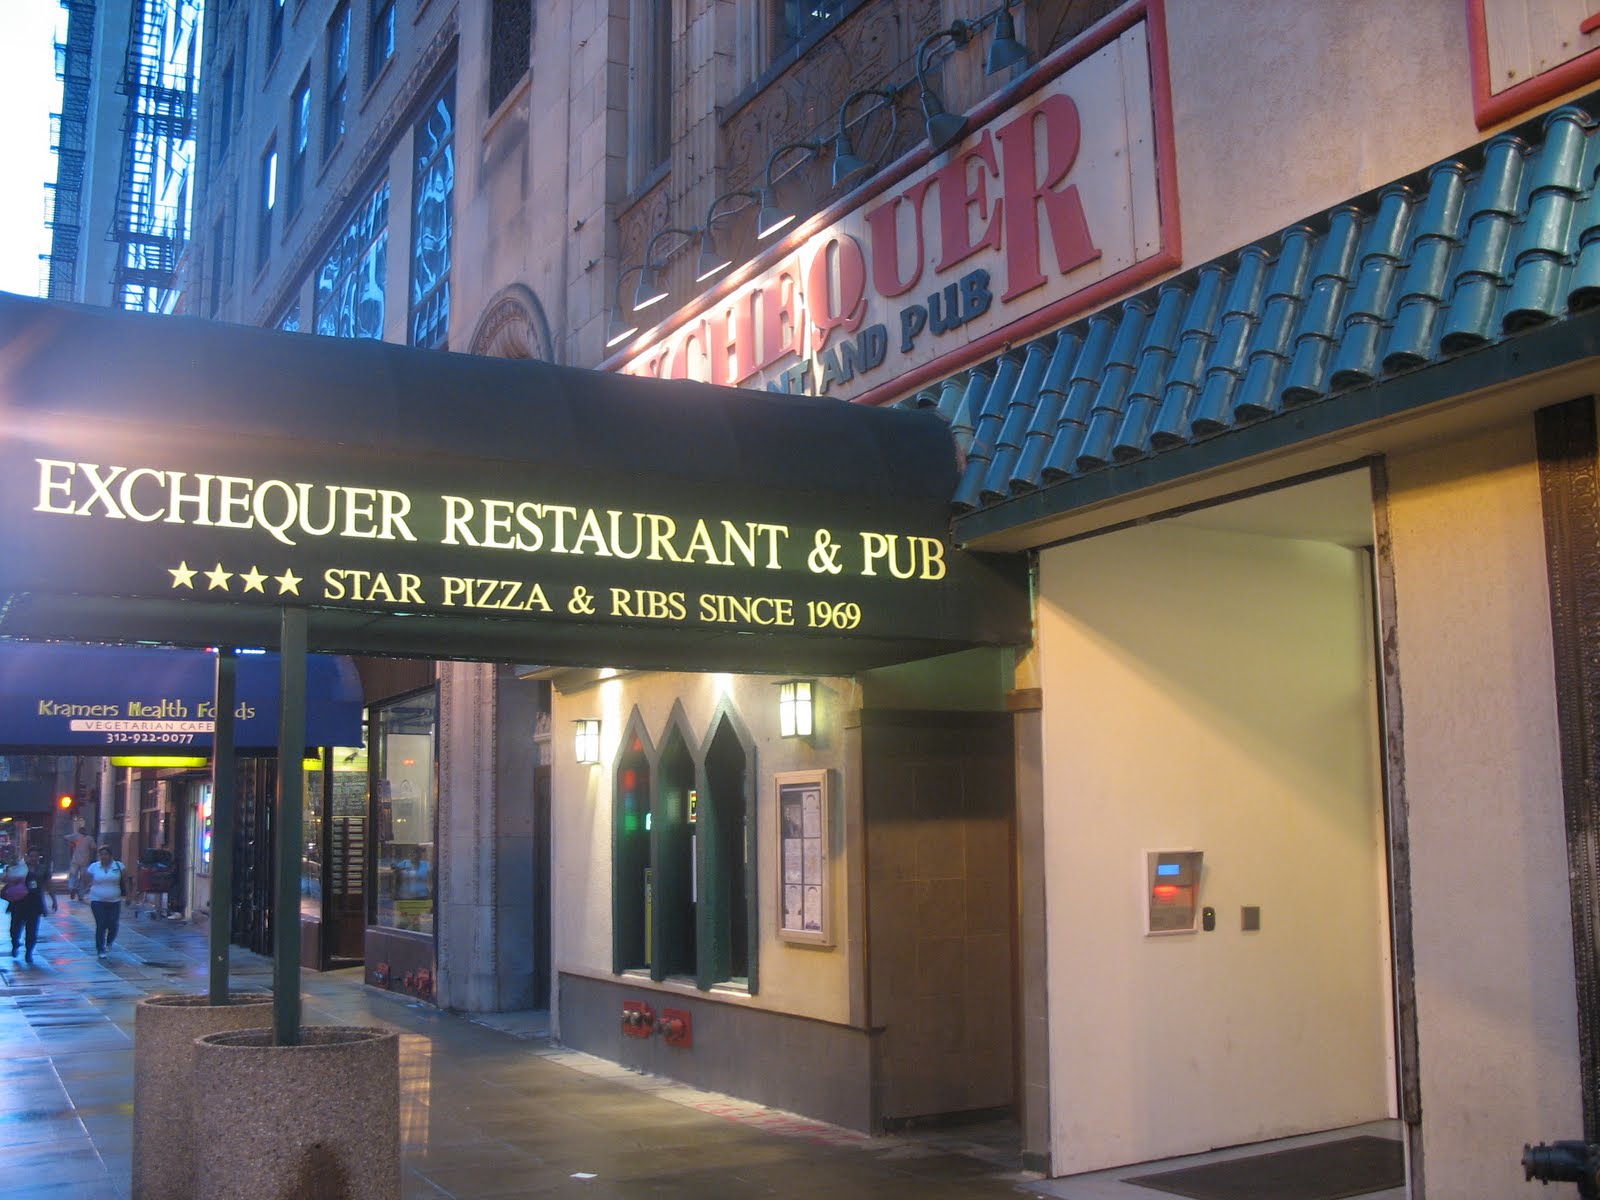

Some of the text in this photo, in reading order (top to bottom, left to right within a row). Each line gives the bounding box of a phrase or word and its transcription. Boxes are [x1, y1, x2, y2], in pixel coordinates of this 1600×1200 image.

[820, 322, 888, 395] AND
[900, 268, 993, 354] PUB
[33, 457, 947, 581] EXCHEQUER RESTAURANT & PUB
[323, 568, 862, 630] STAR PIZZA & RIBS SINCE 1969
[38, 699, 119, 718] Kramers
[128, 698, 188, 719] Health
[85, 721, 214, 732] VEGETARIAN CAFE
[106, 732, 194, 744] 312-922-0077
